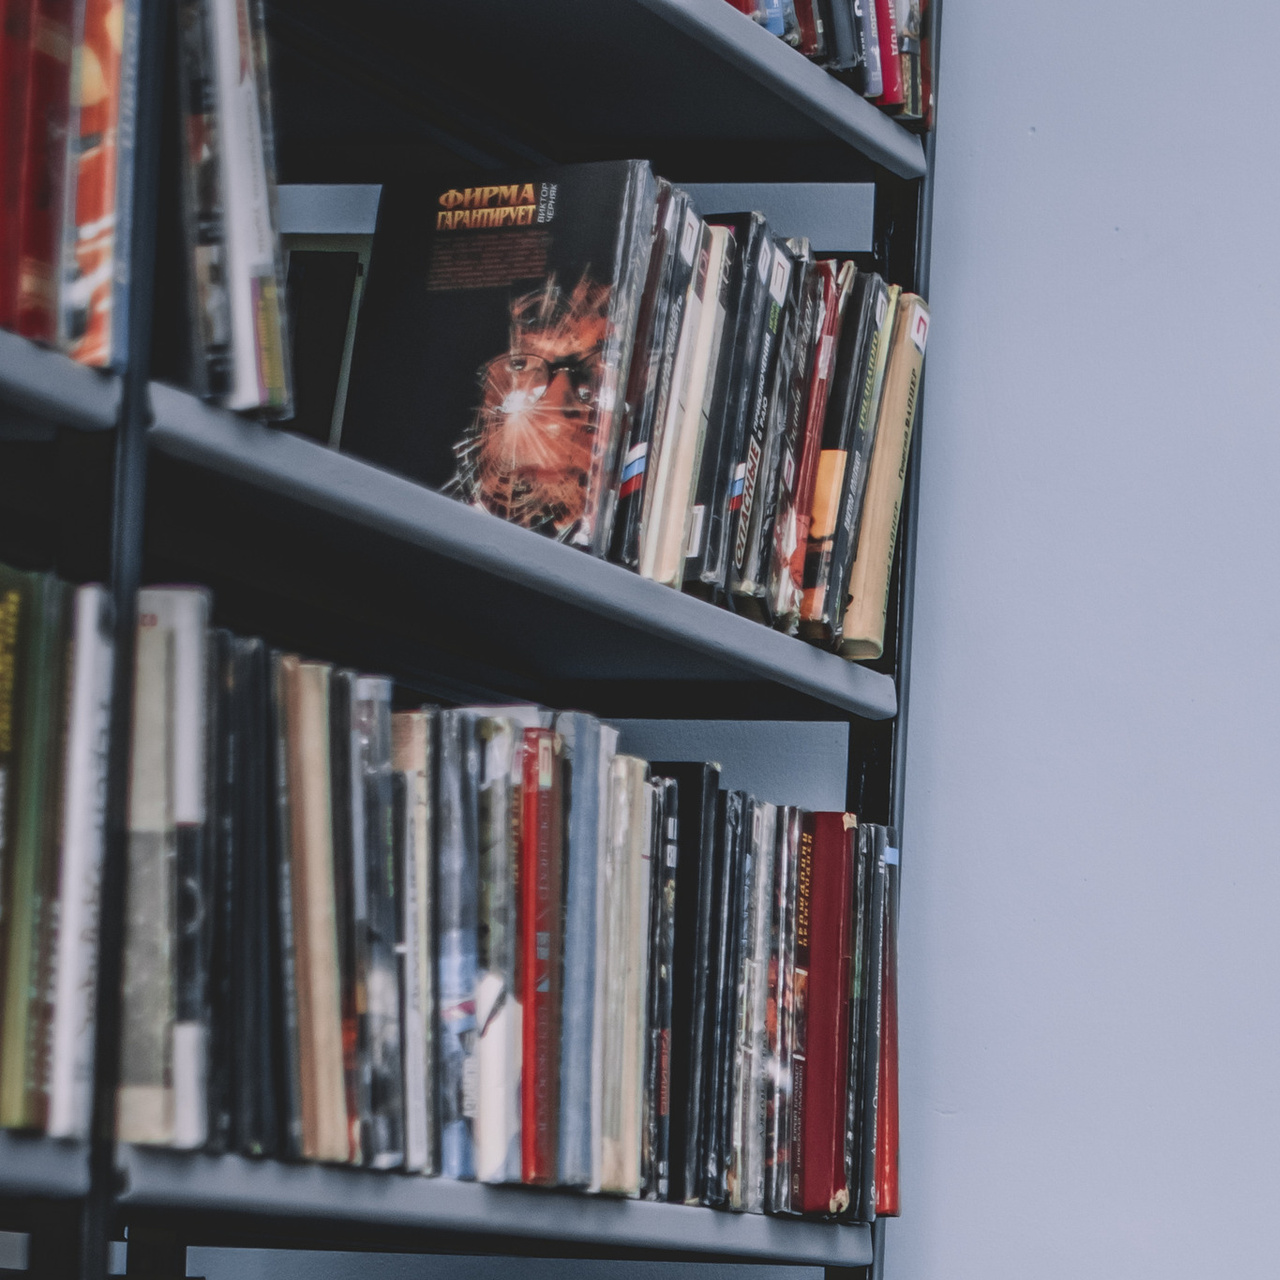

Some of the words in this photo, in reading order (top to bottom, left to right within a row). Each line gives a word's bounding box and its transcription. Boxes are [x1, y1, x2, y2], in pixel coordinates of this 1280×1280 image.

[438, 183, 536, 209] ФИРМА
[537, 182, 547, 224] ВИКТОР
[545, 183, 558, 223] ЧЕРНЯК
[436, 205, 536, 231] ГАРАНТИРУЕТ
[753, 335, 771, 432] ПРИКЛЮЧЕНИЯ
[905, 367, 918, 431] ВАЙНЕР
[760, 396, 769, 423] РАЮ
[735, 444, 760, 563] ОПАСНЫЕ
